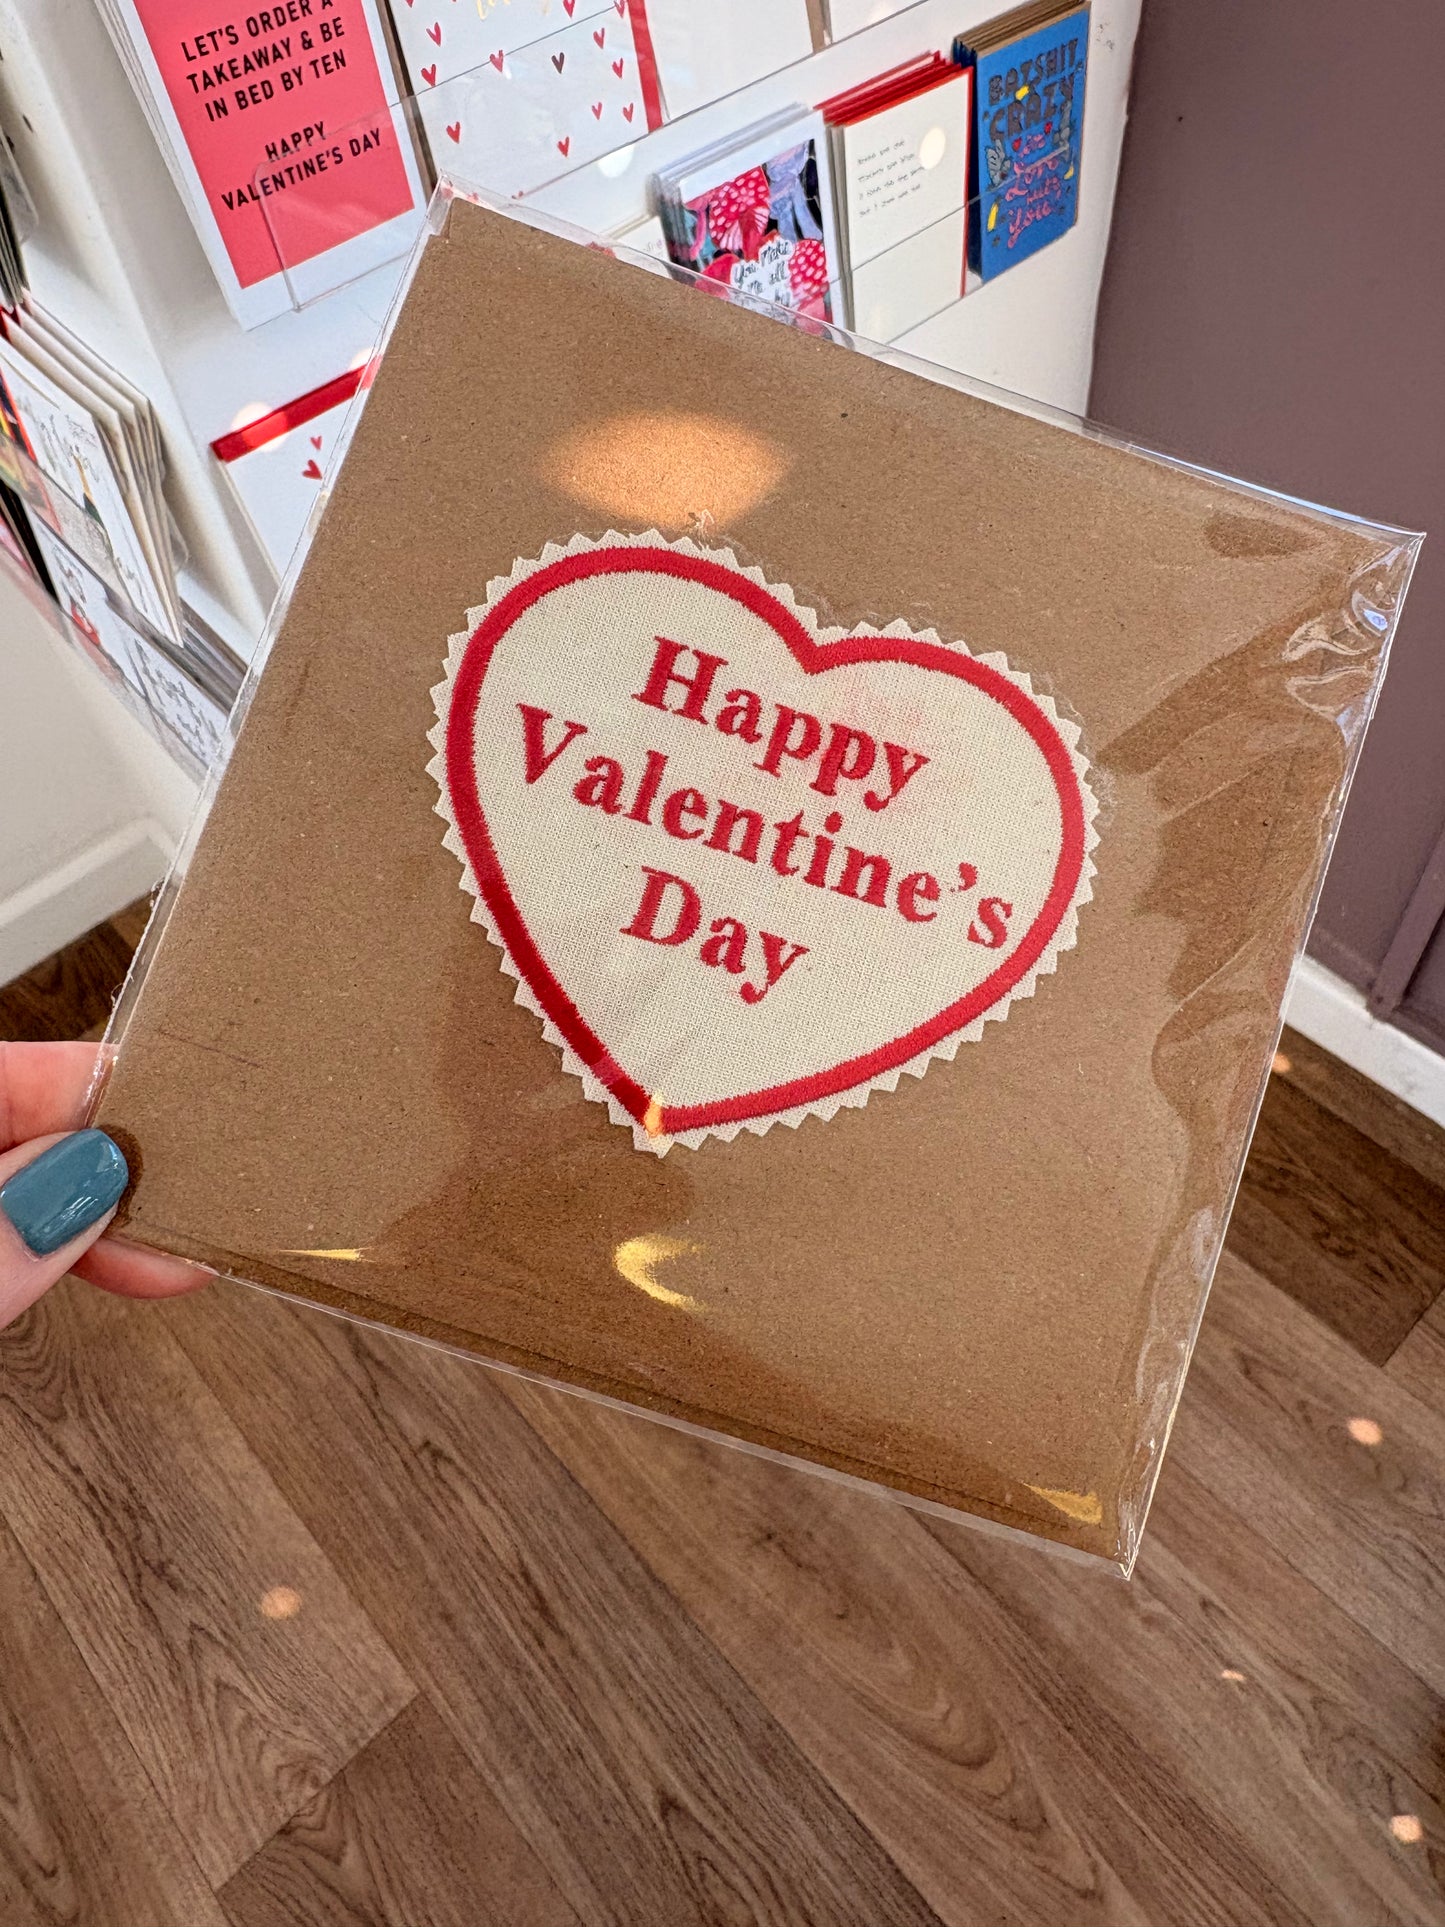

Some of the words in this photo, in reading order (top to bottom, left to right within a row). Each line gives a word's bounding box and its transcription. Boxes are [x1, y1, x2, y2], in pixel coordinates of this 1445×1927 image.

[181, 24, 239, 62] LET'S
[246, 0, 313, 38] ORDER
[186, 37, 292, 94] TAKEAWAY
[301, 31, 314, 50] &
[320, 17, 345, 43] BE
[205, 97, 229, 122] IN
[234, 79, 274, 110] BED
[280, 65, 304, 92] BY
[309, 49, 347, 79] TEN
[988, 38, 1079, 106] BATSHIT
[989, 72, 1075, 143] CRAZY
[221, 146, 343, 211] VALENTINE'S
[349, 128, 381, 157] DAY
[265, 121, 327, 163] HAPPY
[631, 635, 930, 812] Happy
[516, 702, 1014, 951] Valentine's
[620, 866, 810, 1004] Day
